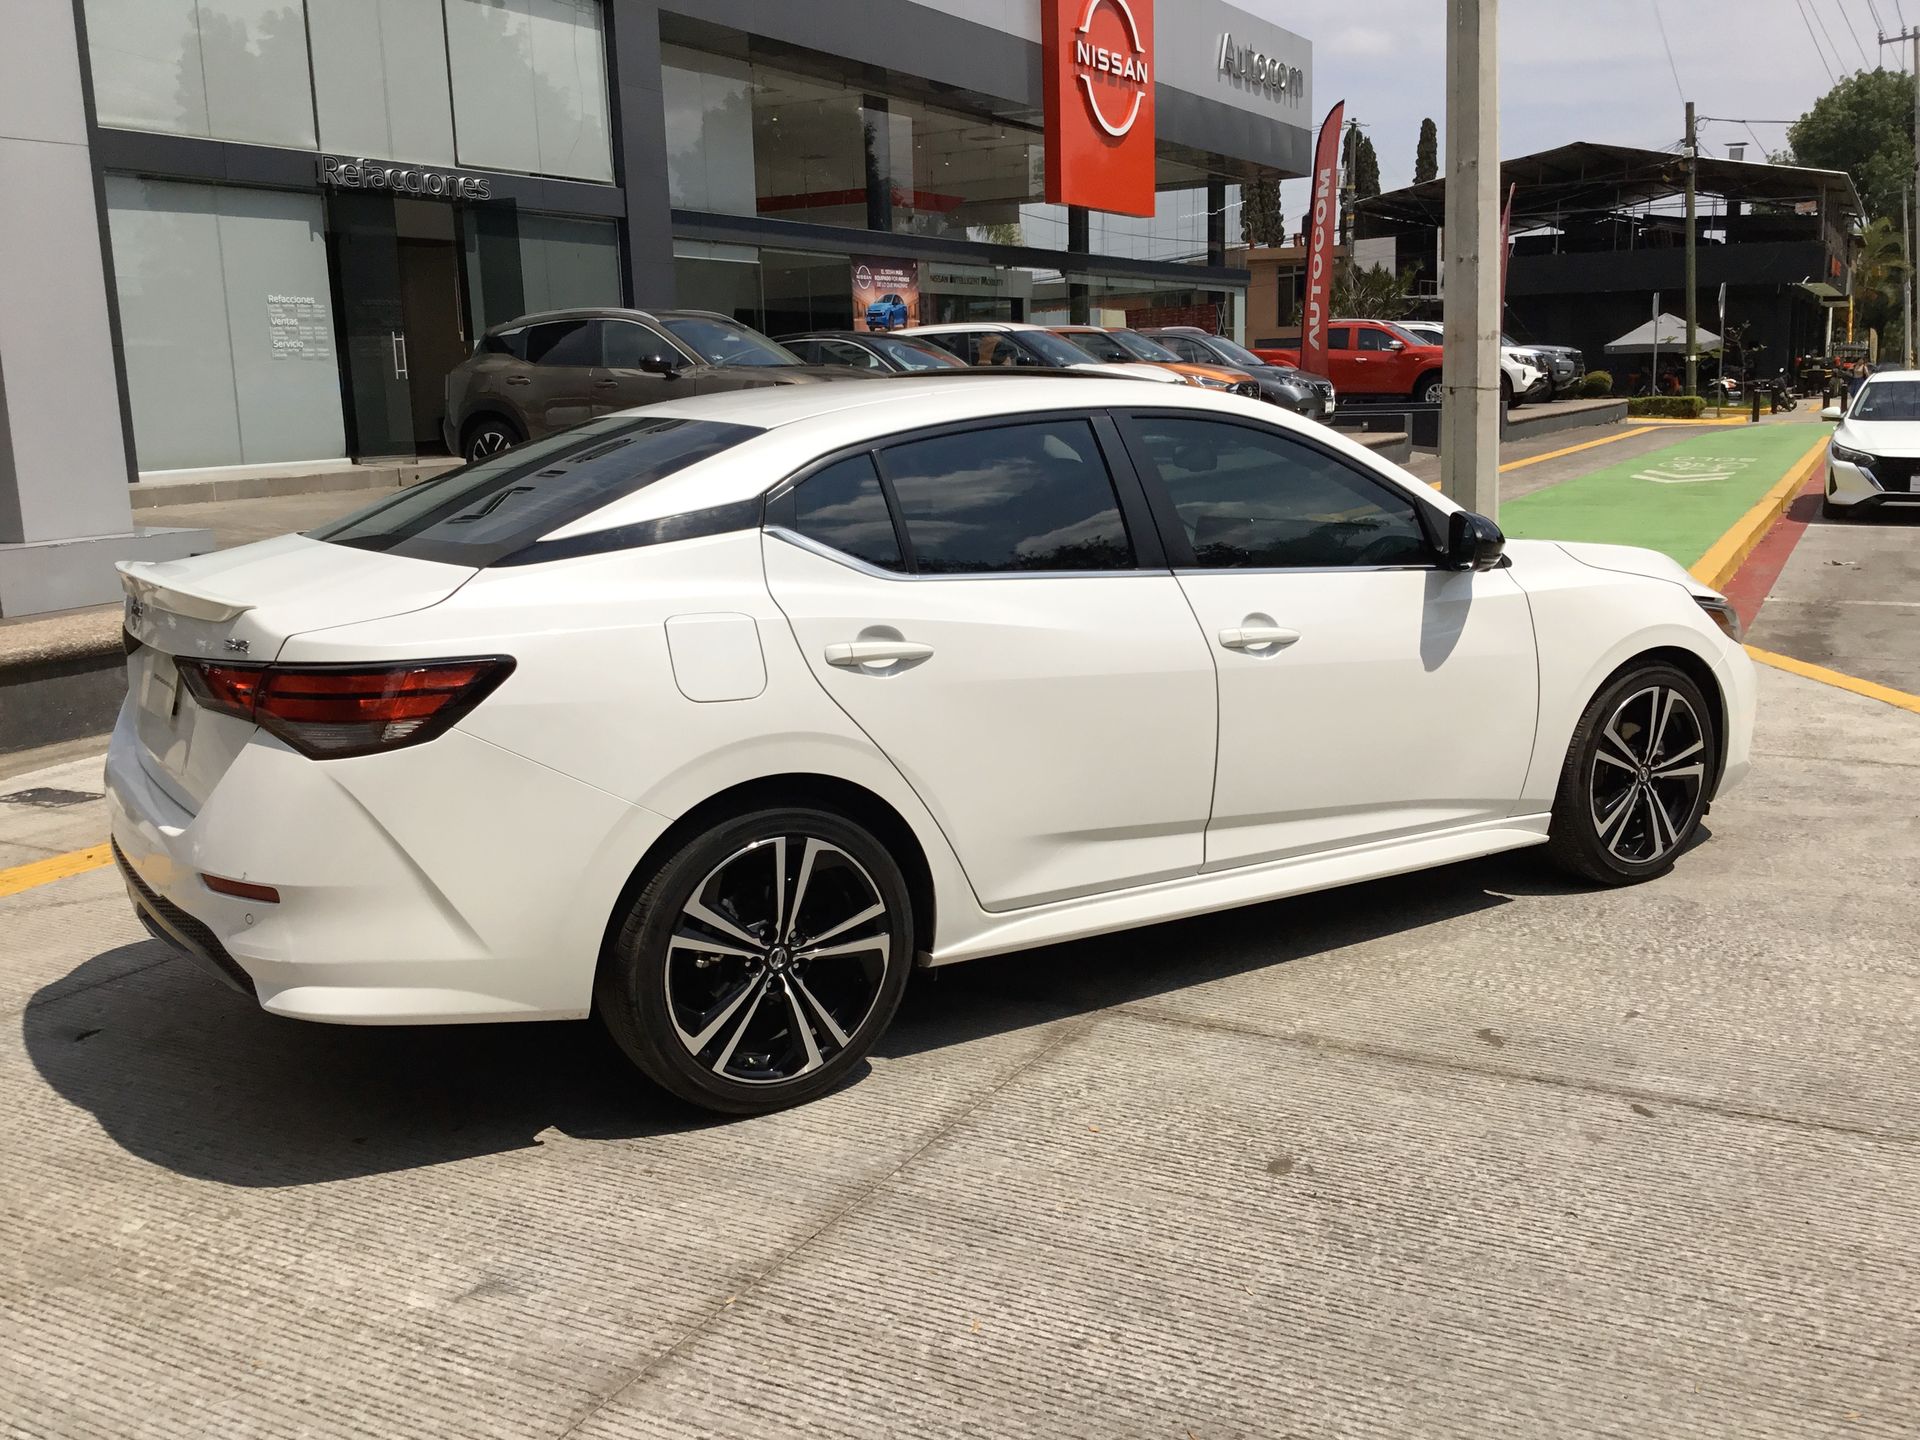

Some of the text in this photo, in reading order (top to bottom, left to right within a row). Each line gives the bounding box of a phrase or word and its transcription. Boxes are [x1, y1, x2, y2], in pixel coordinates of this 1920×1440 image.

[1077, 39, 1148, 84] NISSAN
[1219, 33, 1303, 97] Autocom
[321, 154, 491, 200] Refacciones
[1308, 168, 1331, 350] AUTOCOM
[268, 294, 315, 304] Refacciones
[271, 317, 298, 325] Ventas
[273, 339, 304, 348] Servicio
